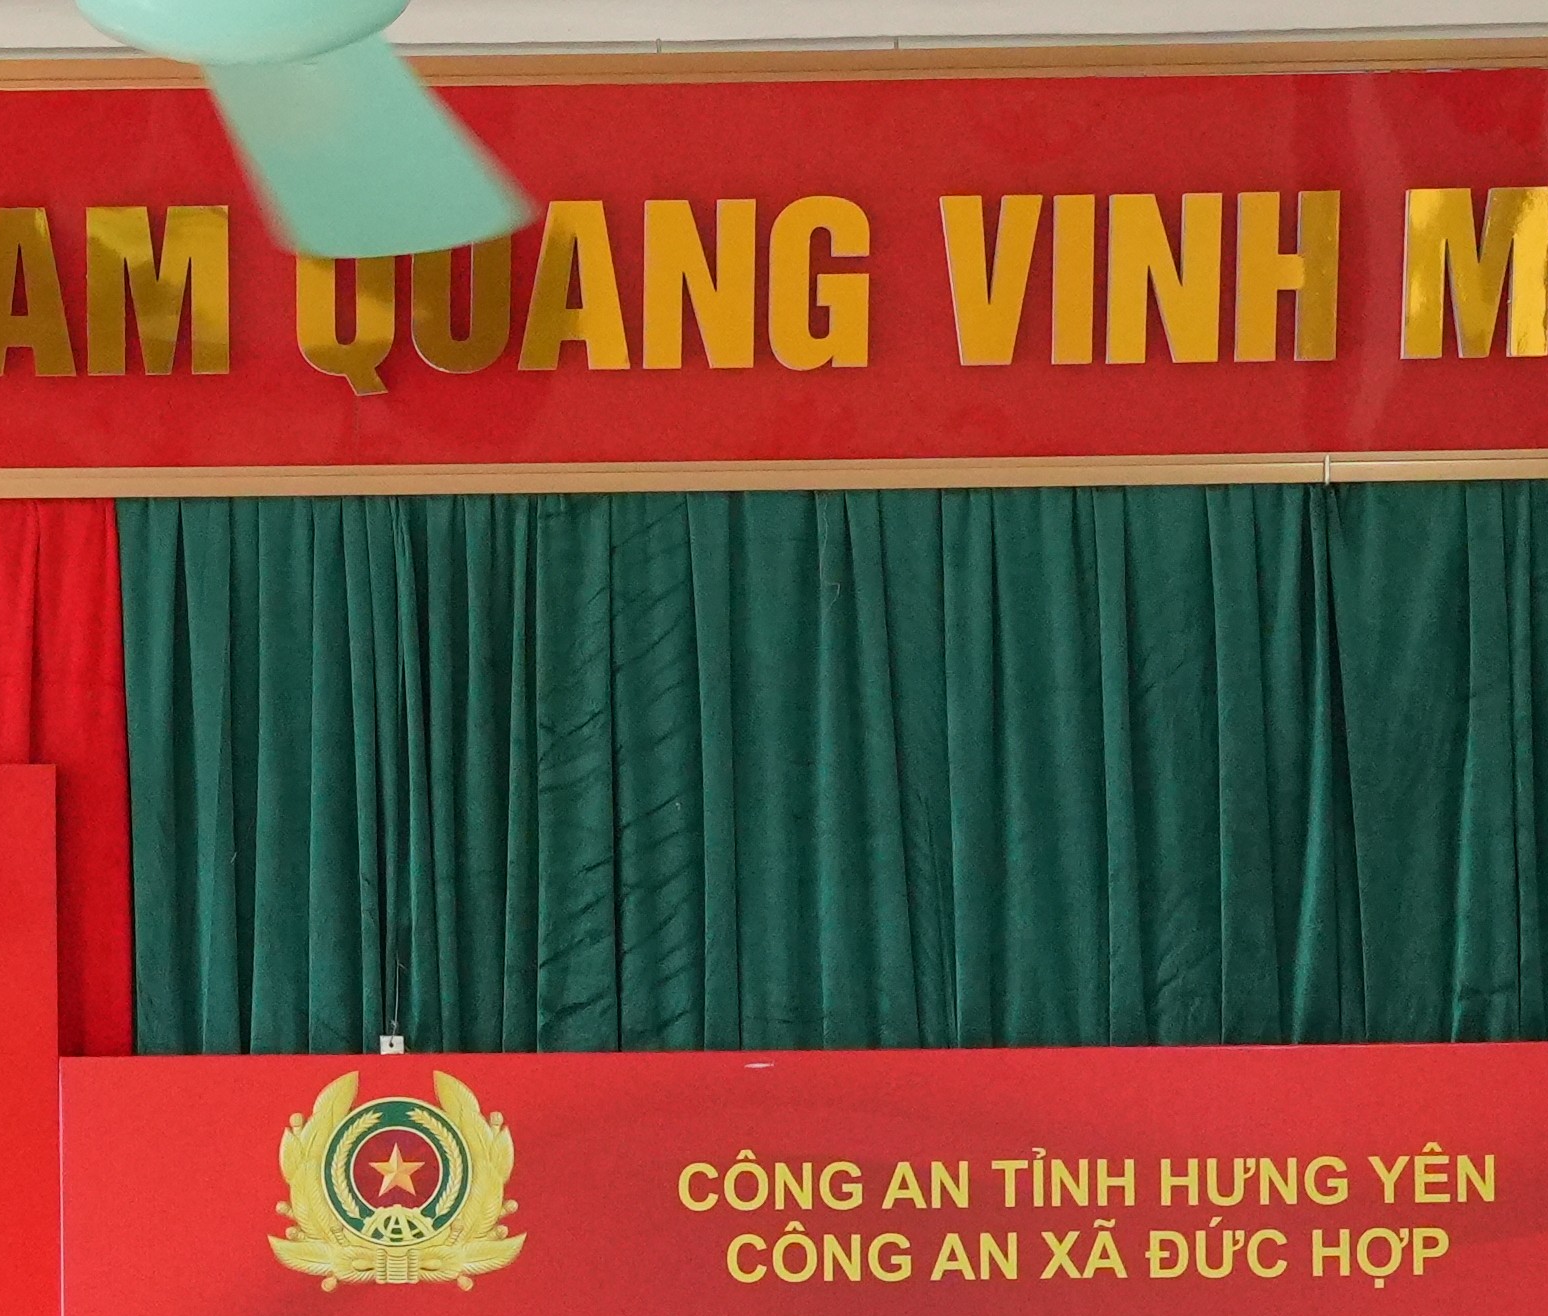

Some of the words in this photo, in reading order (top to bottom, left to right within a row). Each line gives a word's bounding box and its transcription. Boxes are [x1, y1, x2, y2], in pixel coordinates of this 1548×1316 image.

[295, 195, 871, 396] QUANG
[940, 189, 1340, 366] VINH
[678, 1148, 863, 1212] CÔNG
[881, 1160, 969, 1210] AN
[991, 1147, 1136, 1208] TỈNH
[1160, 1154, 1349, 1207] HƯNG
[1368, 1141, 1496, 1204] YÊN
[726, 1220, 912, 1284] CÔNG
[930, 1232, 1018, 1281] AN
[1040, 1219, 1128, 1280] XÃ
[1145, 1226, 1282, 1279] ĐỨC
[1304, 1227, 1450, 1289] HỢP
